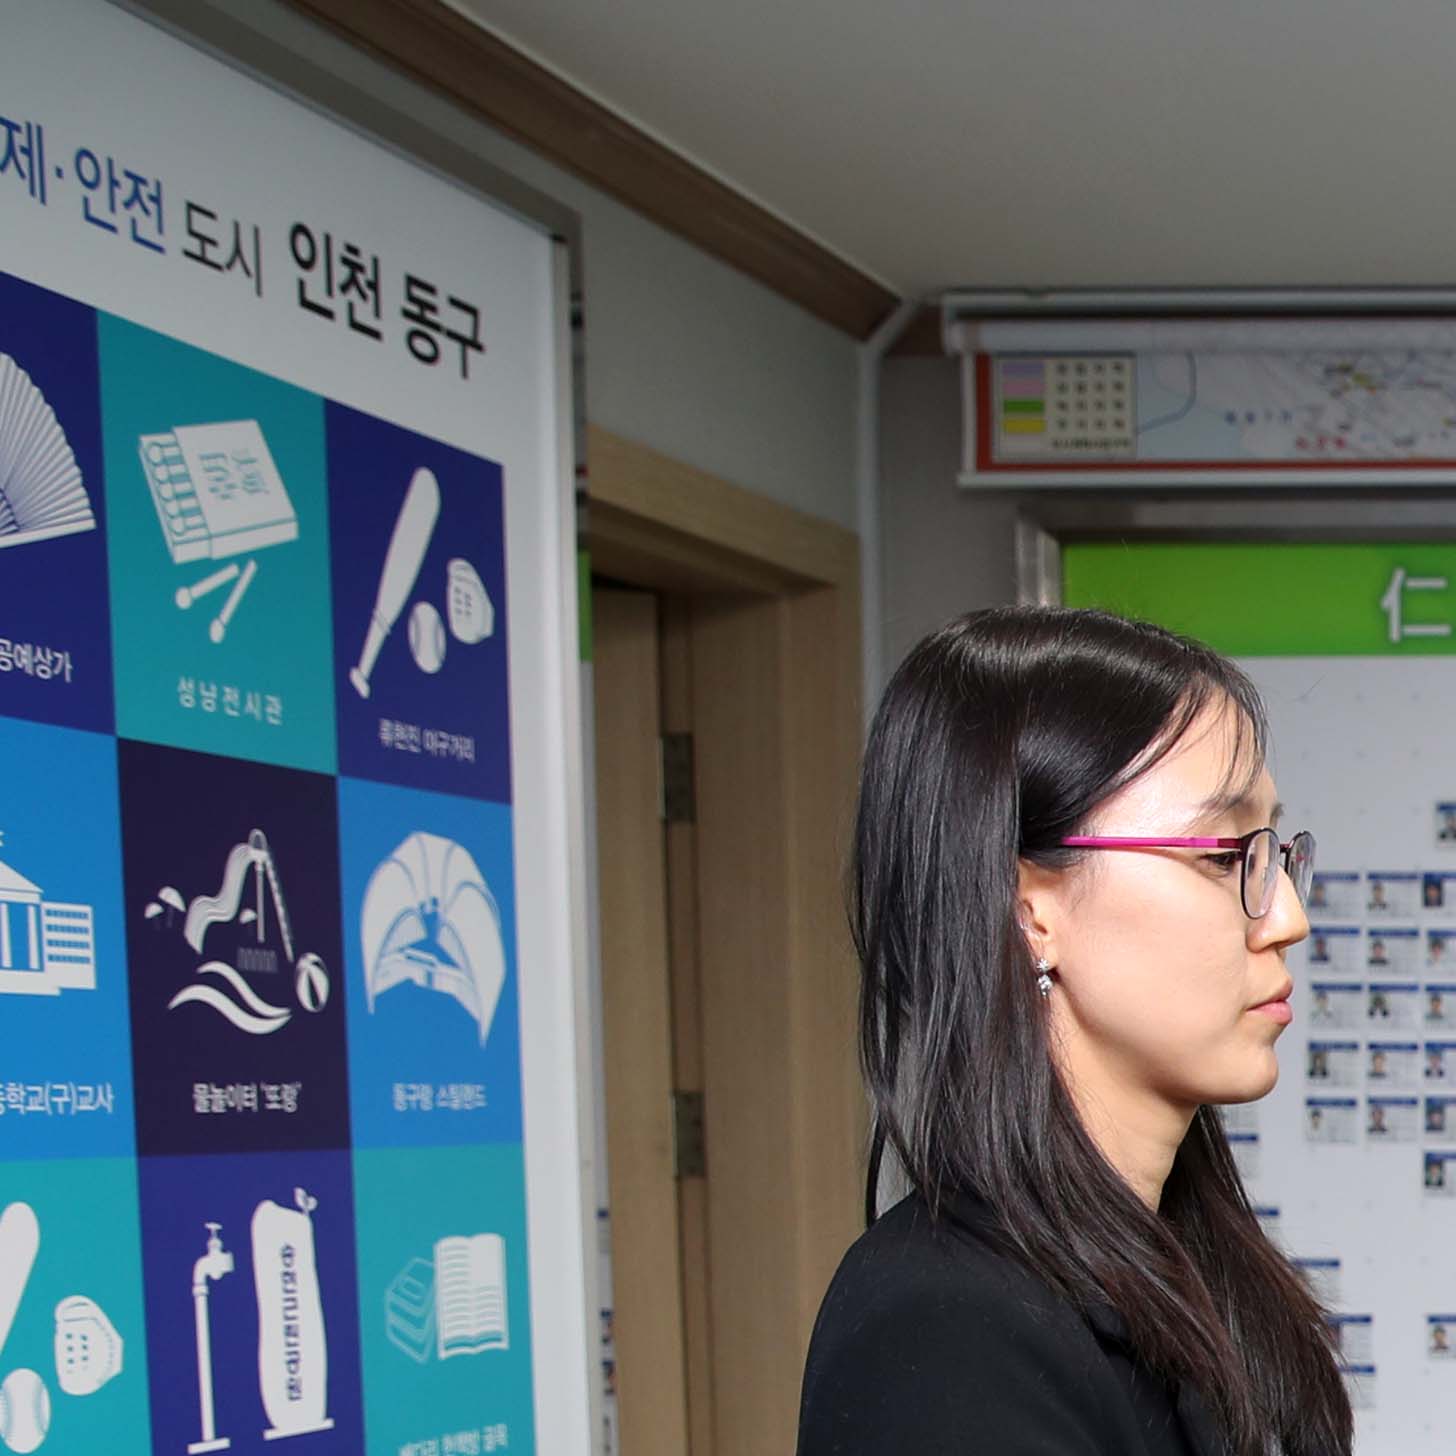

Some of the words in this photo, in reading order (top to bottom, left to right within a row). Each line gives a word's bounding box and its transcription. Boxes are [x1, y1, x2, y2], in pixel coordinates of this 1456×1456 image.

[182, 200, 264, 299] 도시
[288, 222, 384, 343] 인천
[401, 273, 486, 379] 동구
[0, 1081, 115, 1116] 학교(구)교사
